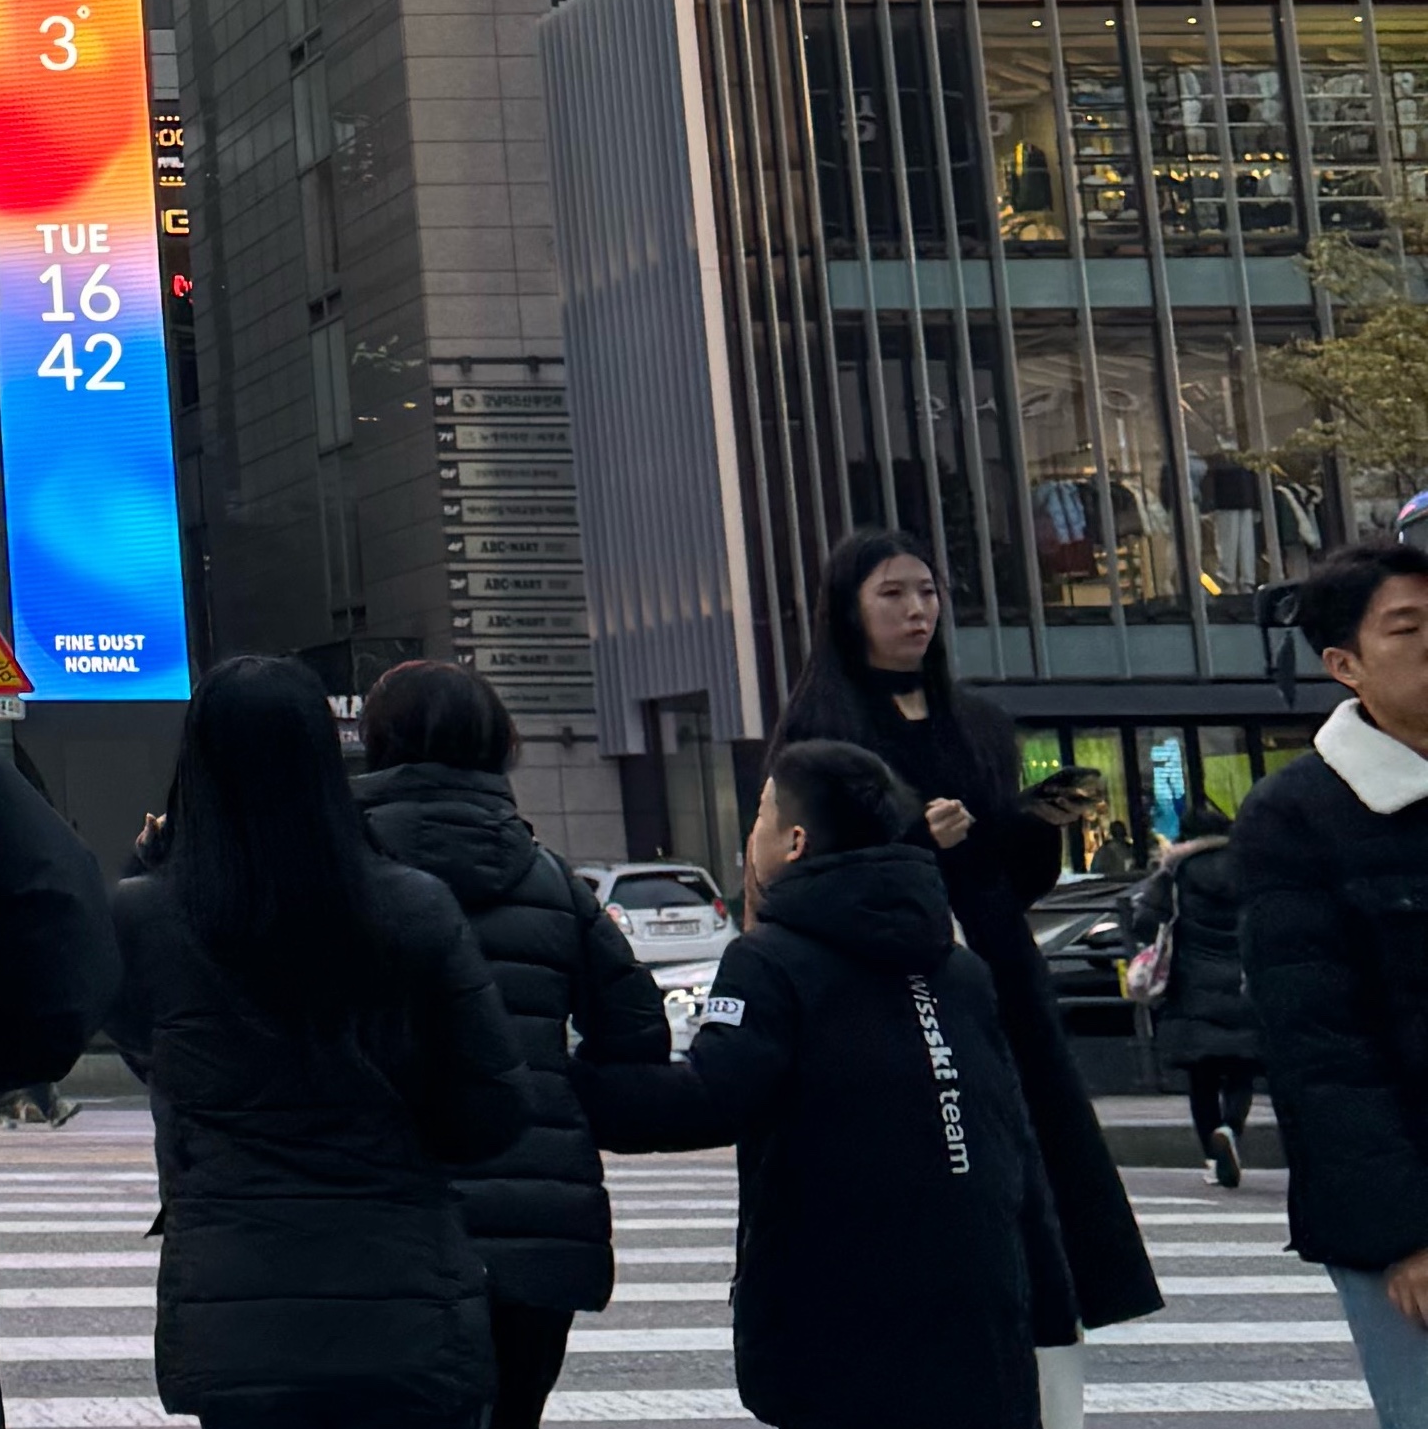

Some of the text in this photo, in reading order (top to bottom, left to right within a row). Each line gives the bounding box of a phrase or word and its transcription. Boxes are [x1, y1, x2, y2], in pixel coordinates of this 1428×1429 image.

[35, 223, 112, 255] TUE
[38, 263, 121, 323] 16
[37, 332, 126, 392] 42
[54, 634, 146, 651] FINE DUST
[64, 656, 141, 674] NORMAL
[939, 1088, 970, 1174] team
